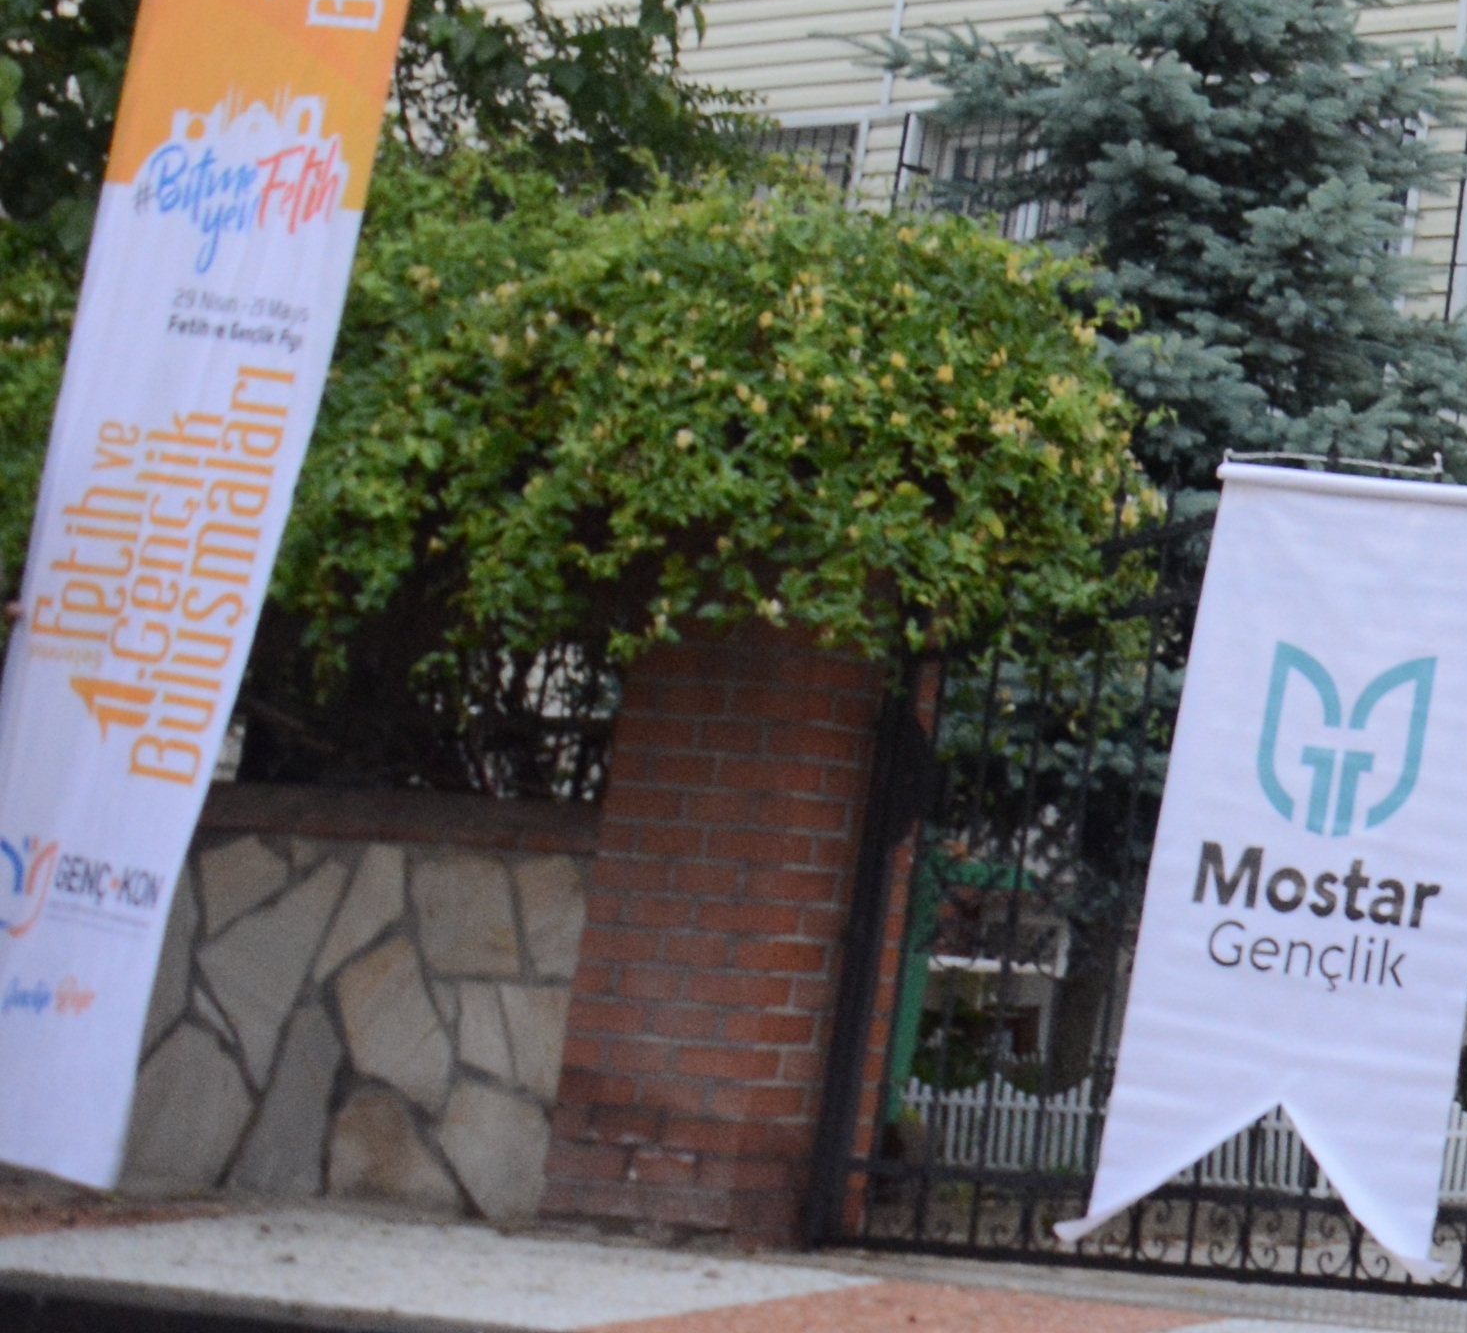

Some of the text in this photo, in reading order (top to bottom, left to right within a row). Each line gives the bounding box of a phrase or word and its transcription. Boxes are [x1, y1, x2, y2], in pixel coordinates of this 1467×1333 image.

[256, 139, 340, 235] Fetih
[30, 485, 147, 642] Fetih
[91, 420, 139, 472] ve
[127, 364, 295, 786] Buluşmaları
[1192, 840, 1442, 928] Mostar
[1208, 920, 1405, 992] Gençlik
